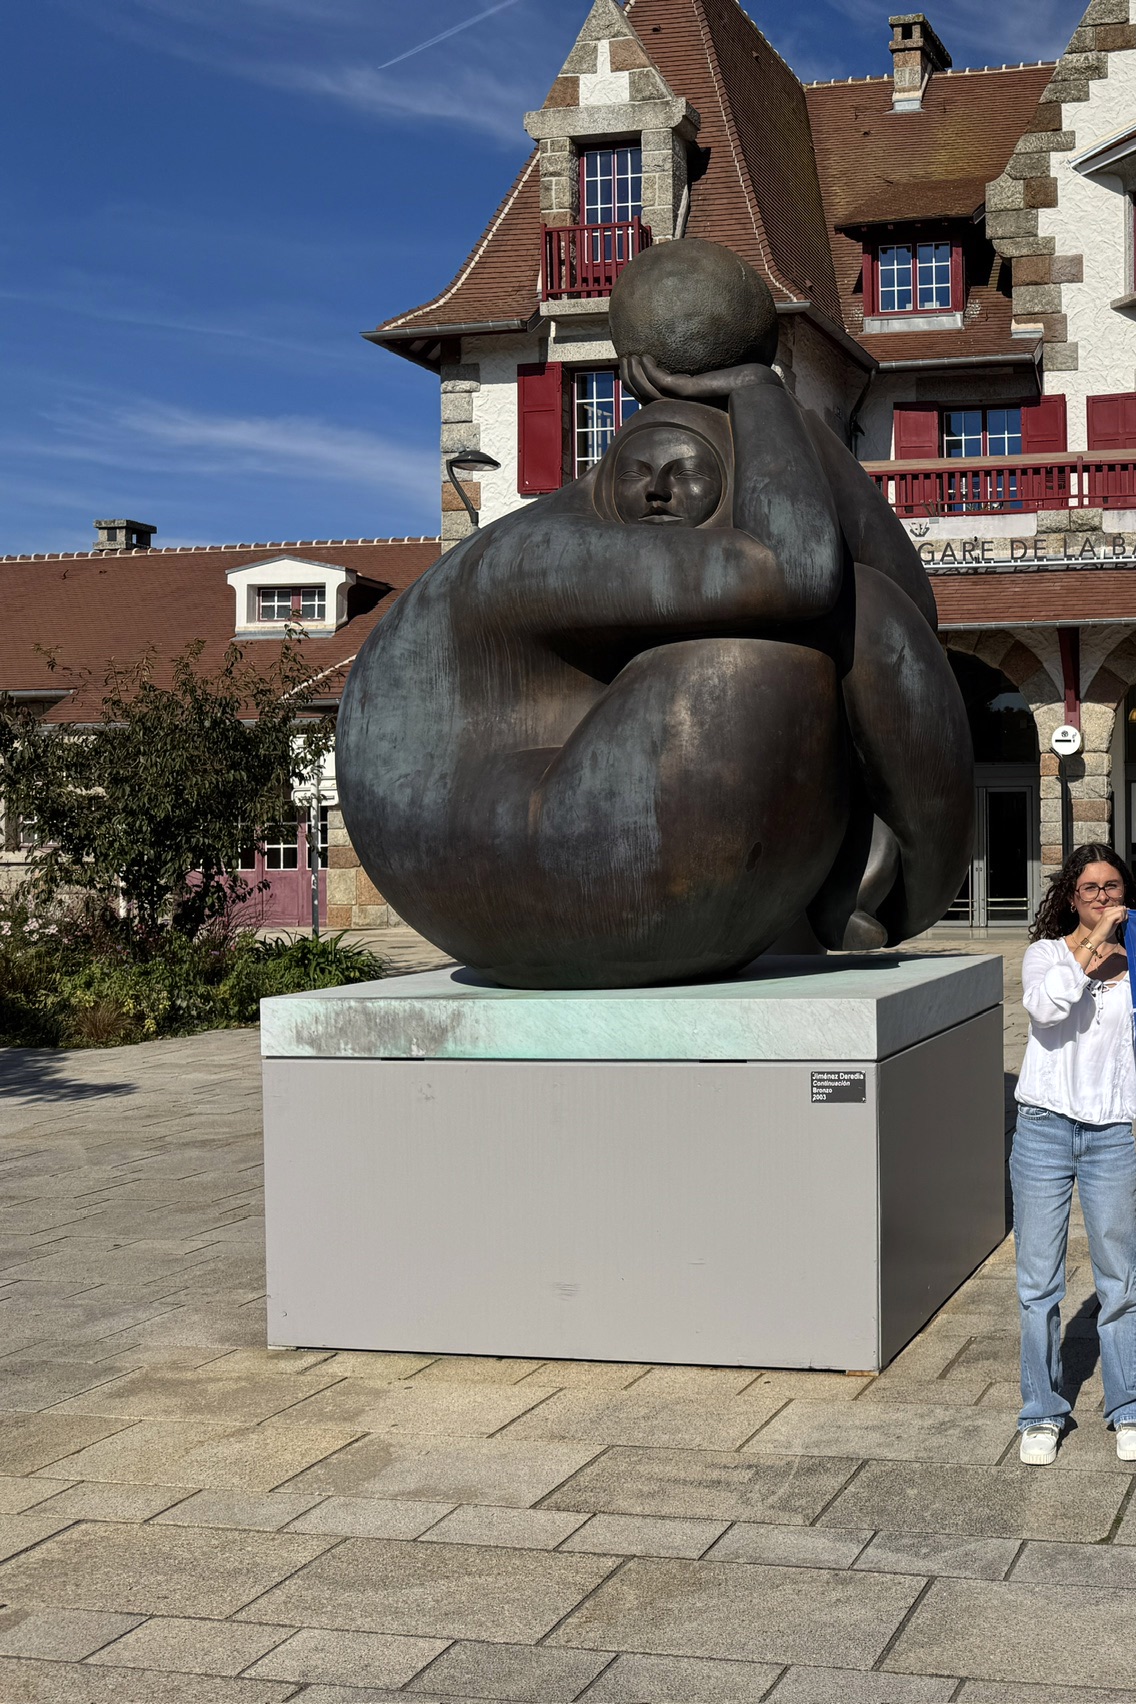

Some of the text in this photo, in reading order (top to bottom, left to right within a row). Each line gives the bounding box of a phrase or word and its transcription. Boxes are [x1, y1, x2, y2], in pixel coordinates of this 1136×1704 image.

[917, 540, 995, 563] GARE
[1010, 538, 1047, 561] DE
[1063, 536, 1097, 560] LA
